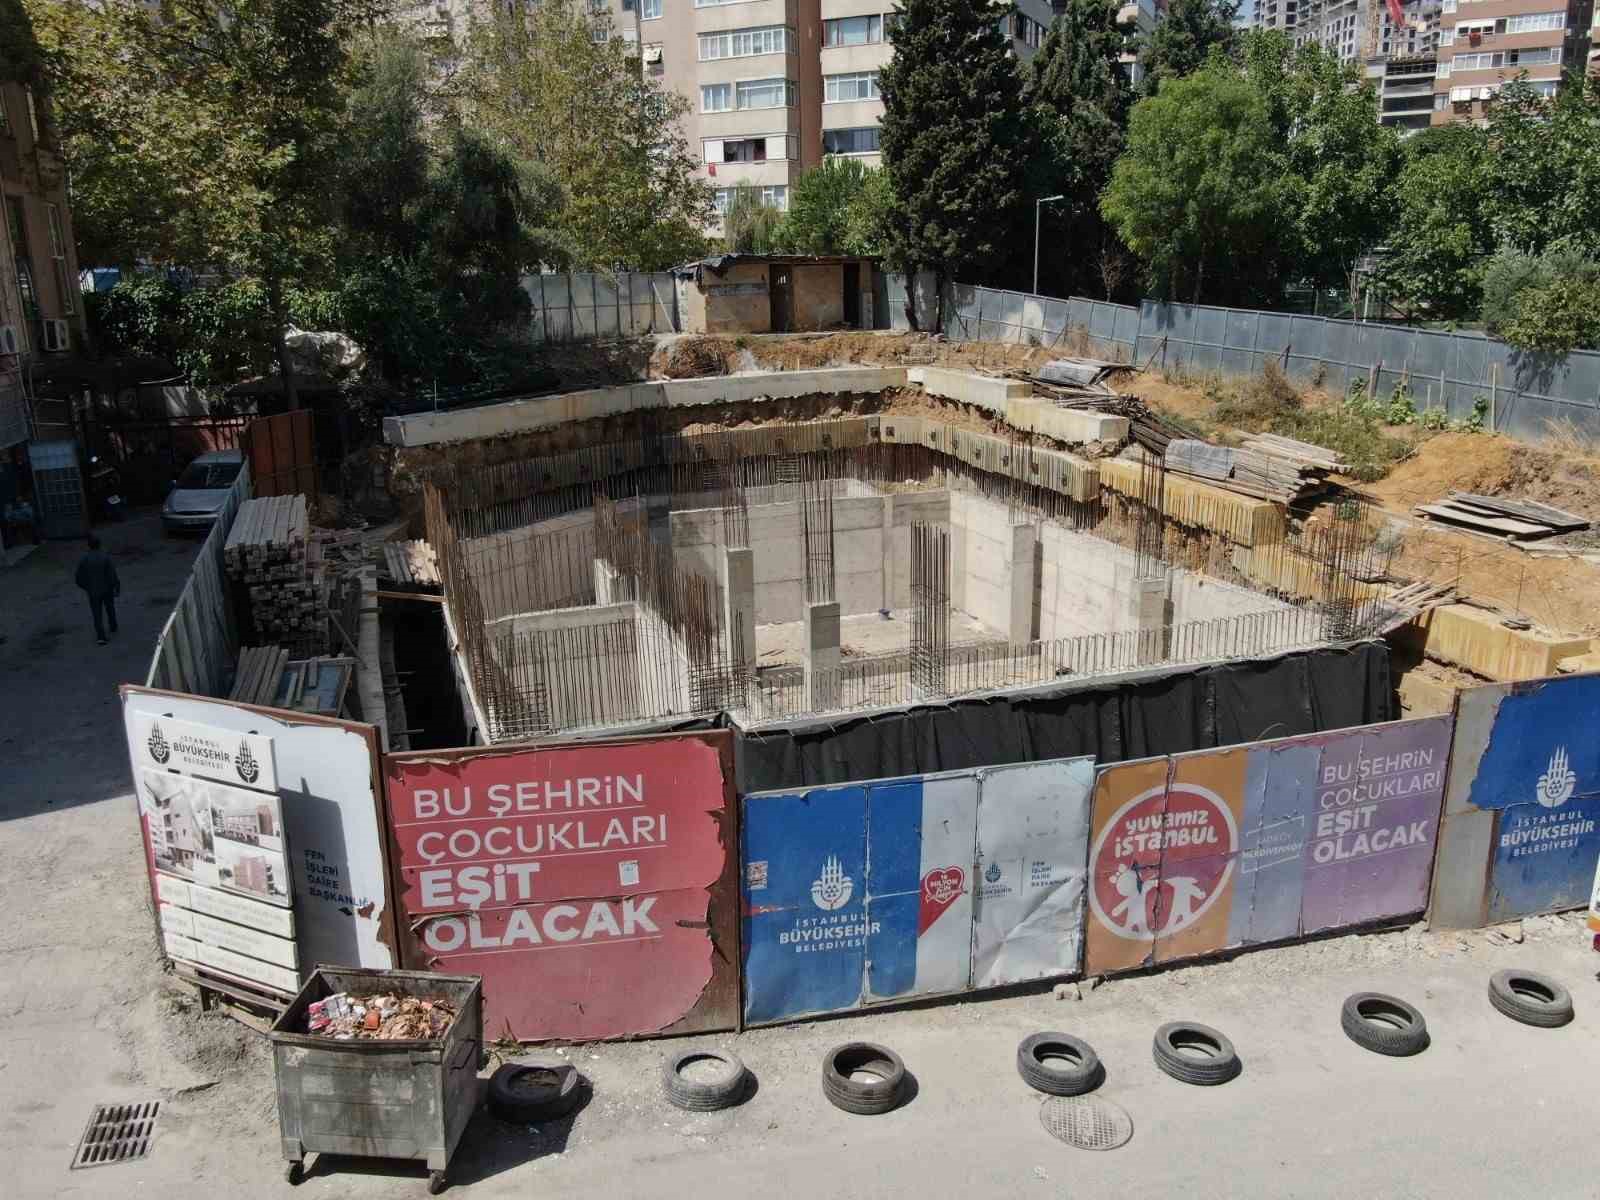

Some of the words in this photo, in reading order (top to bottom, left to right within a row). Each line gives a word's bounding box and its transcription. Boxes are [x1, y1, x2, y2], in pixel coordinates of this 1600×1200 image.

[173, 742, 231, 763] BÜYÜKŞEHİR
[1323, 765, 1351, 784] BU
[1359, 748, 1433, 780] ŞEHRİN
[413, 786, 472, 818] BU
[487, 774, 645, 818] ŞEHRİN
[1320, 770, 1441, 810] ÇOCUKLARI
[1316, 804, 1377, 841] EŞİT
[1500, 820, 1595, 848] BÜYÜKŞEHİR
[1517, 810, 1583, 827] İSTANBUL
[416, 814, 667, 865] ÇOCUKLARI
[1313, 821, 1429, 864] OLACAK
[1513, 838, 1579, 857] BELEDİYESİ
[419, 862, 540, 911] EŞİT
[424, 897, 660, 951] OLACAK
[779, 921, 881, 945] BÜYÜKŞEHİR
[795, 913, 869, 929] İSTANBUL
[795, 938, 867, 953] BELEDİYESİ
